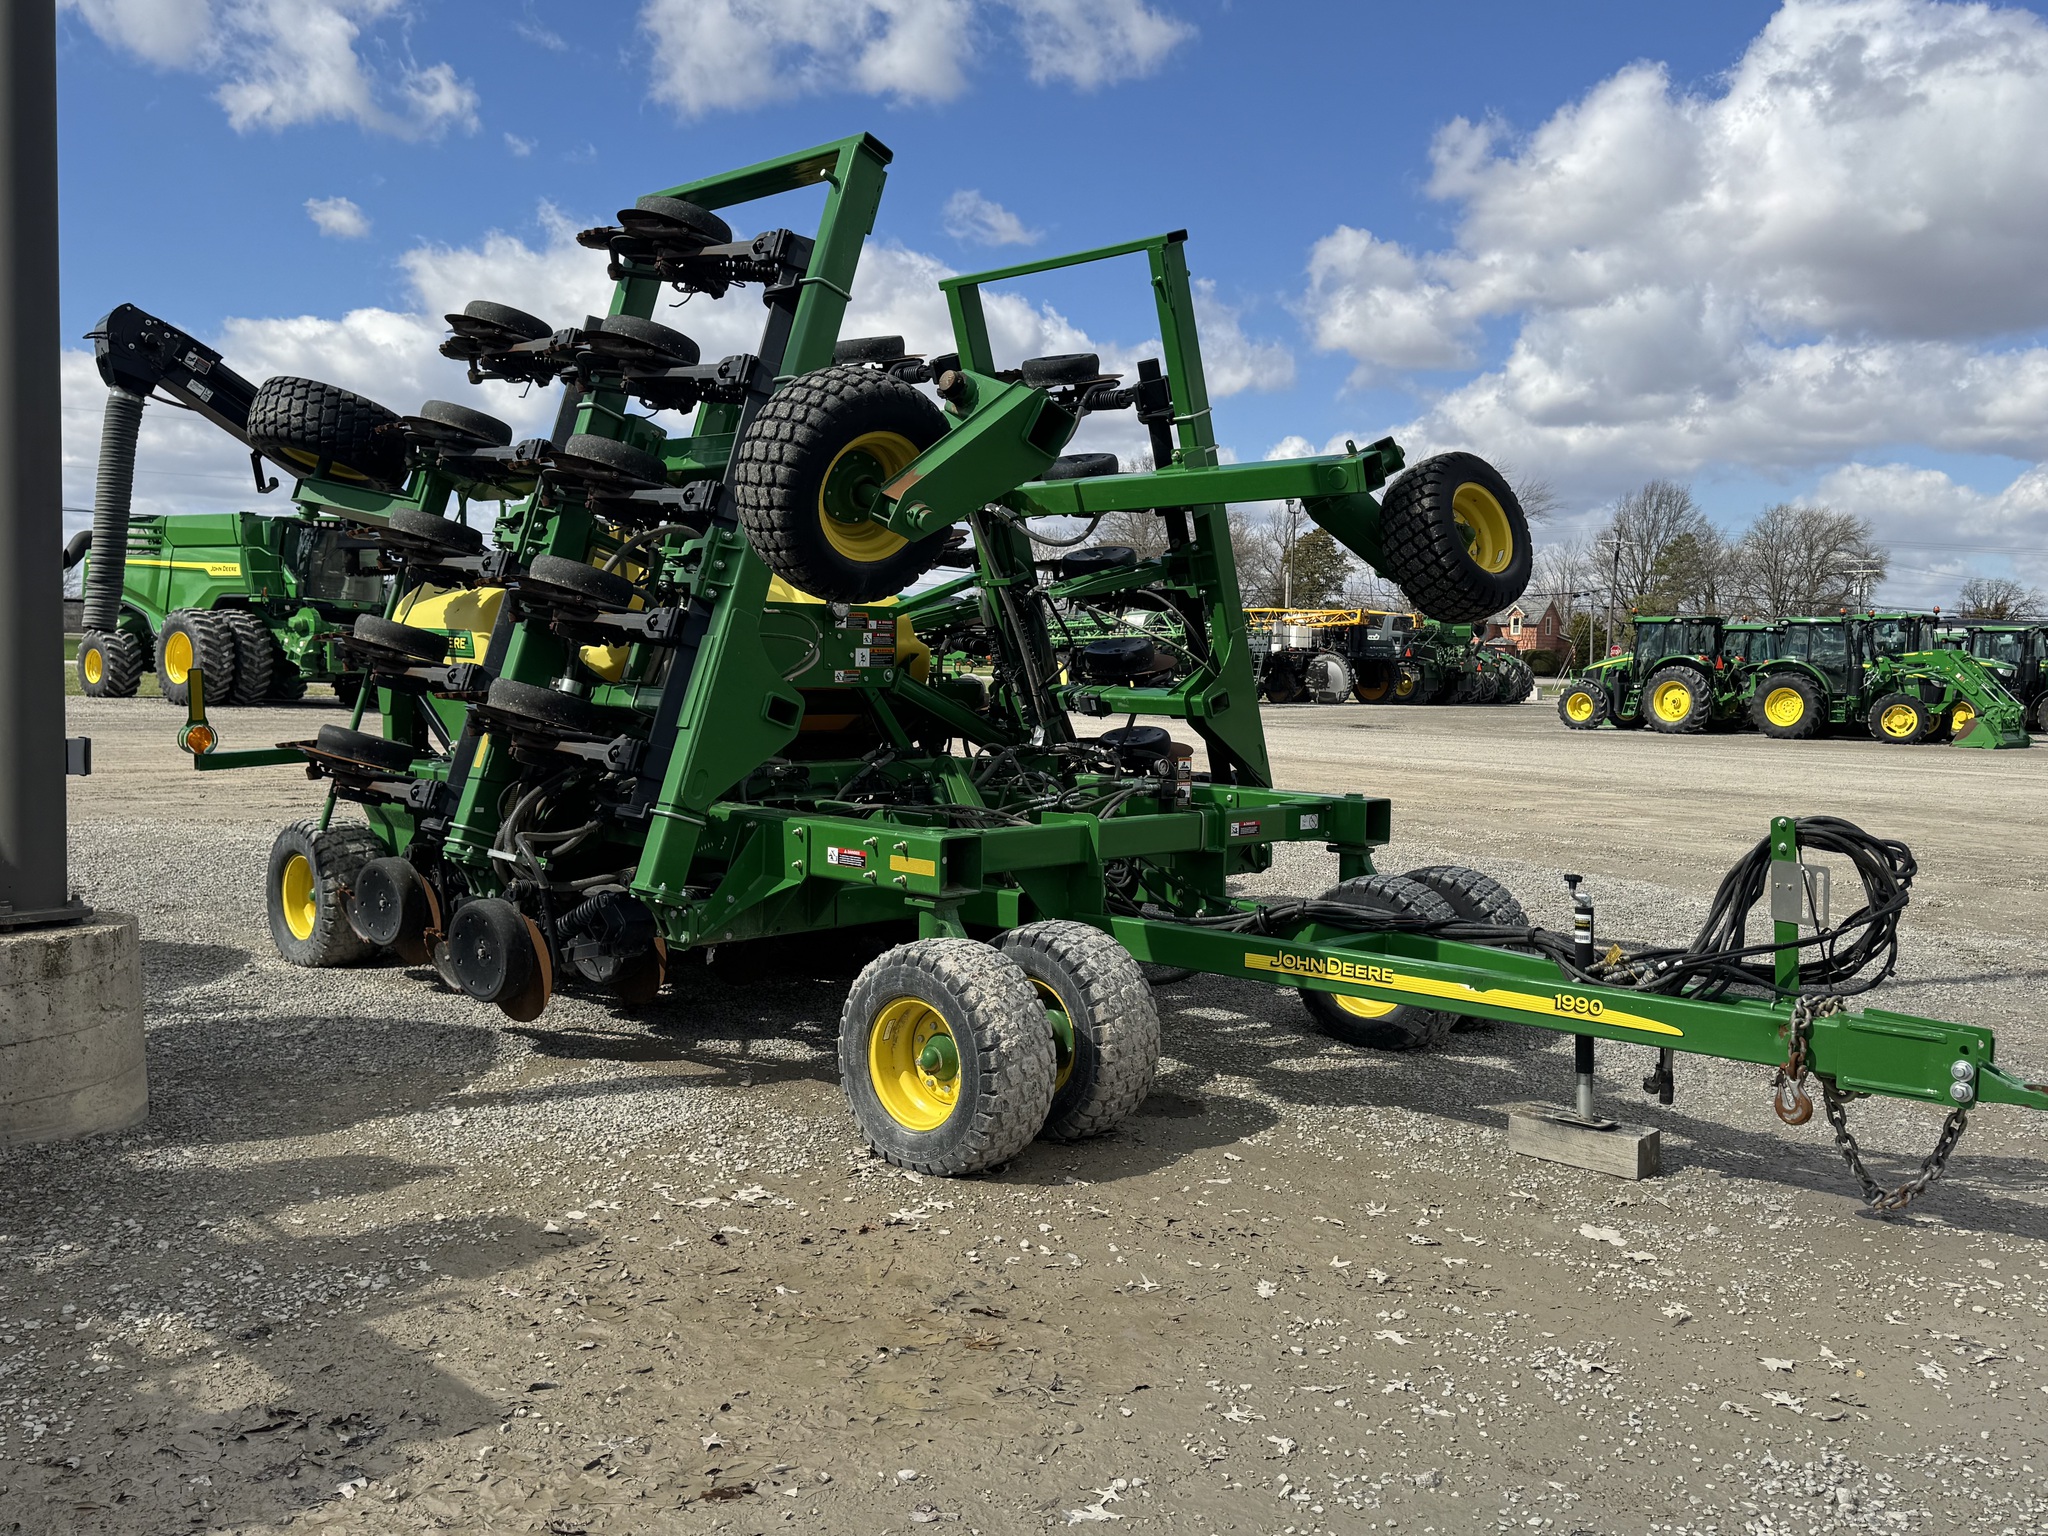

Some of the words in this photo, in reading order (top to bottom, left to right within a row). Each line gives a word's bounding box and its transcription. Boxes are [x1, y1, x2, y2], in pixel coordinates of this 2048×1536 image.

[448, 636, 467, 649] ERE
[1270, 949, 1325, 973] JOHN
[1325, 956, 1394, 984] DEERE
[1554, 993, 1604, 1016] 1990
